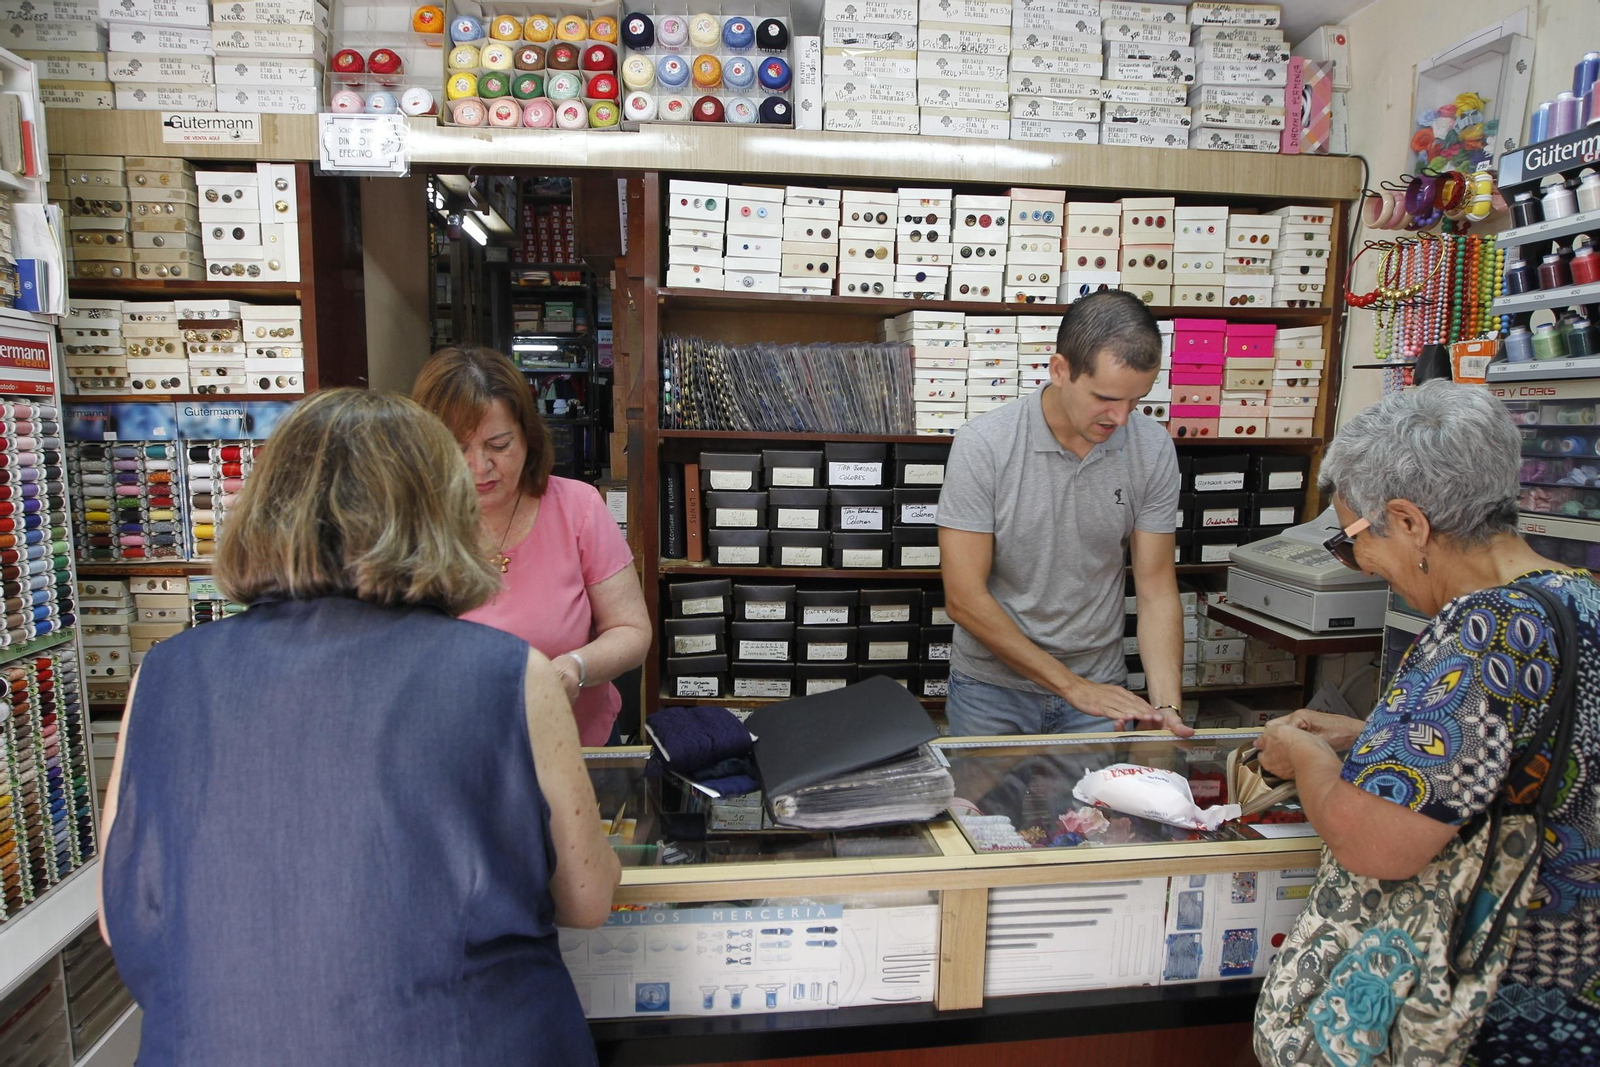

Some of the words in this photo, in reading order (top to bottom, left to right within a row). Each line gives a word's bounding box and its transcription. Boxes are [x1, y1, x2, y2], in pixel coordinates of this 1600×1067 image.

[1290, 112, 1299, 147] DIADEMA
[339, 149, 372, 158] EFECTIVO
[1509, 389, 1516, 398] y
[1520, 387, 1556, 396] Coats
[689, 498, 697, 524] LANAS
[1215, 644, 1229, 655] 18
[1220, 663, 1232, 675] 18
[712, 907, 826, 921] MERCERIA
